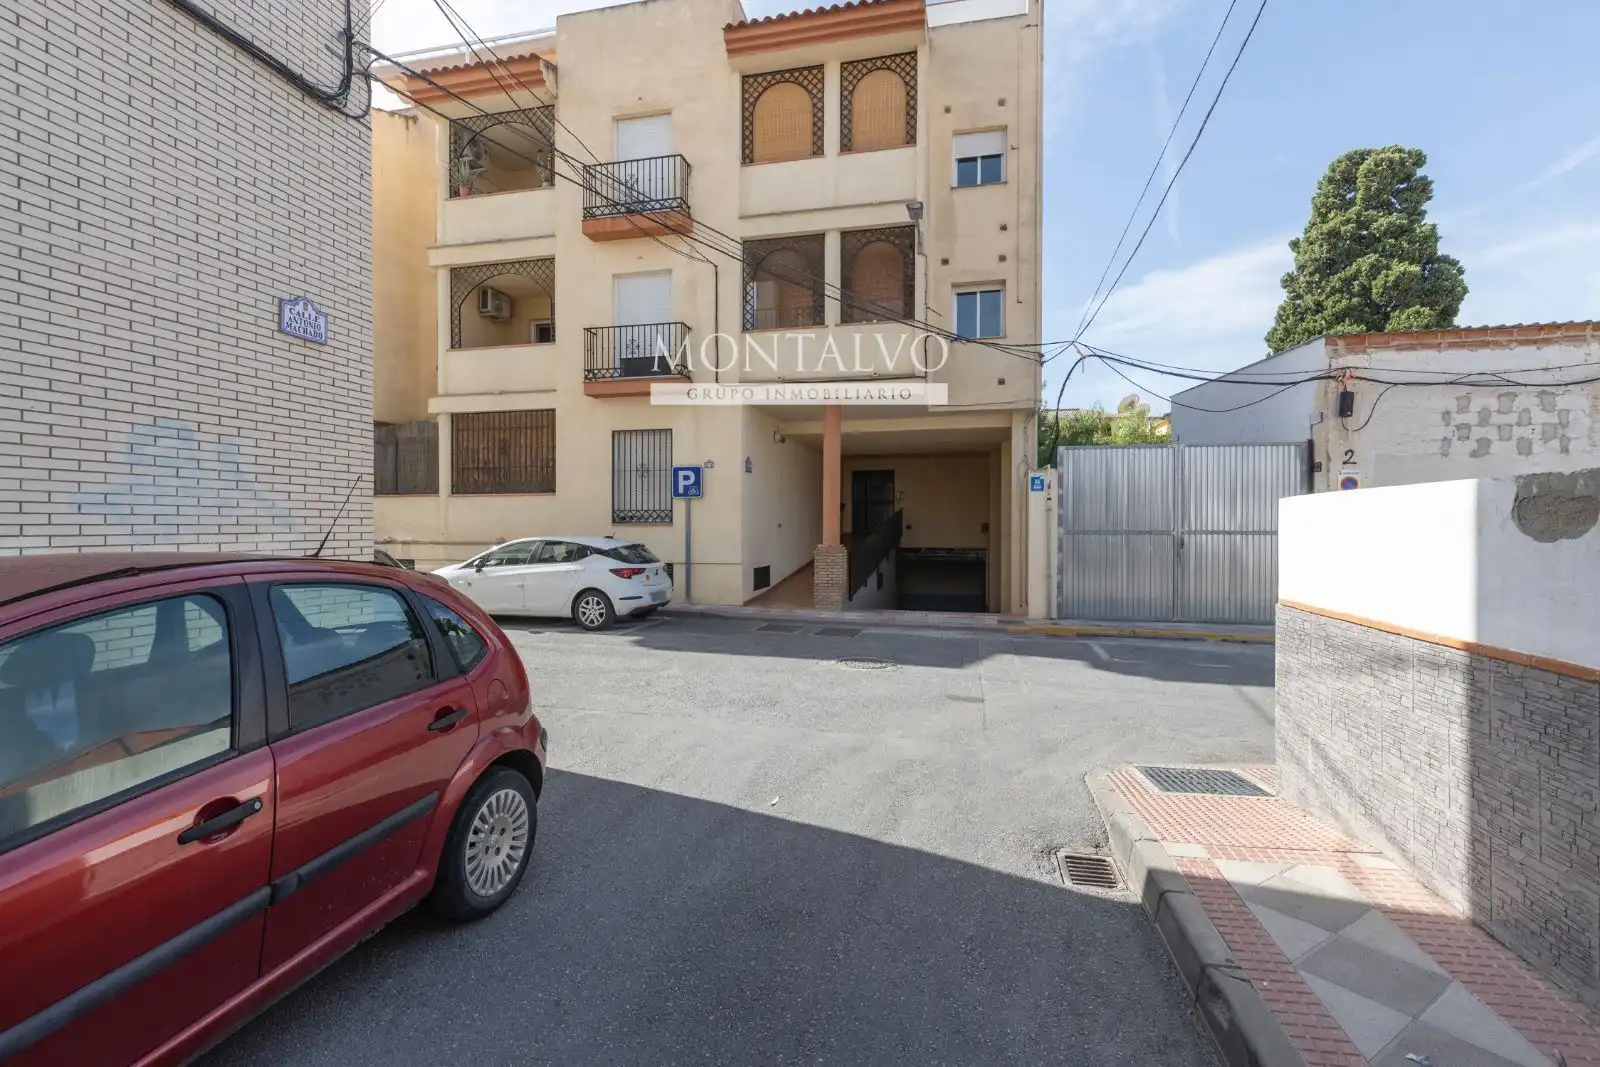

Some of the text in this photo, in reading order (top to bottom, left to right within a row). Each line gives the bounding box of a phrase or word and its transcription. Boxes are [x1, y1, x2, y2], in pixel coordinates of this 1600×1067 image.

[288, 315, 321, 332] ANTONIO
[289, 308, 320, 323] CALLE
[286, 321, 323, 339] MACHADO
[1342, 449, 1357, 465] 2
[678, 470, 696, 494] P
